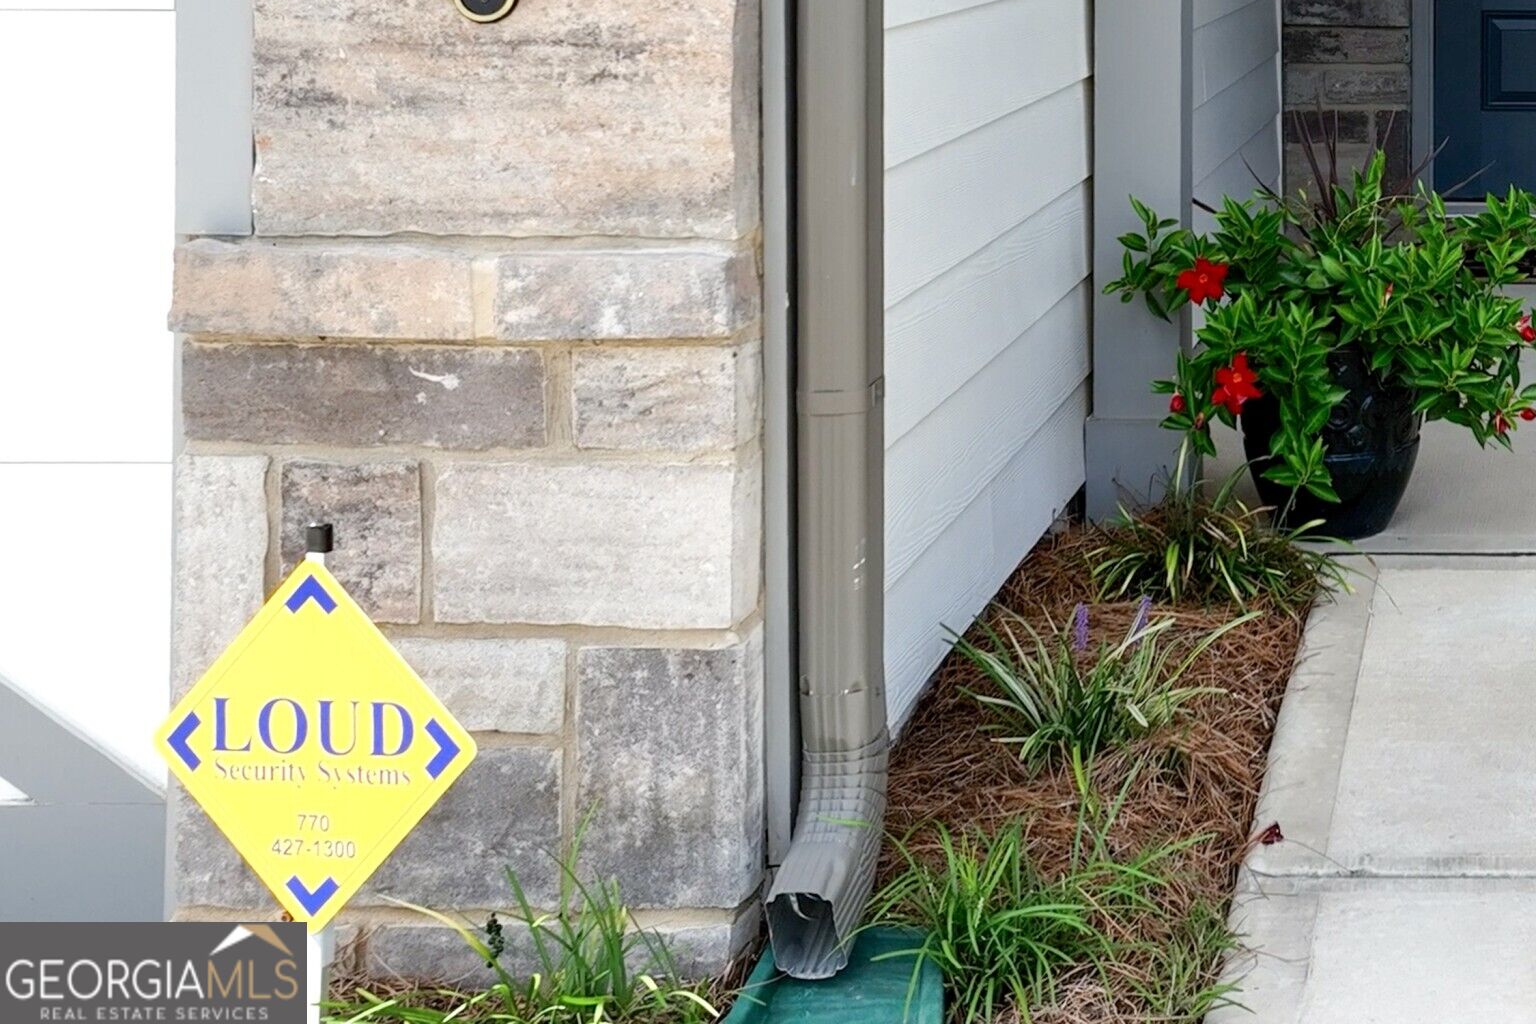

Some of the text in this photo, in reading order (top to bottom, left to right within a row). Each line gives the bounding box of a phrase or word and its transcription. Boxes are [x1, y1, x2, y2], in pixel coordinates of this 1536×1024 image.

[212, 697, 414, 756] LOUD
[214, 759, 412, 790] Security Systems
[297, 813, 330, 833] 770
[271, 838, 357, 859] 427-1300
